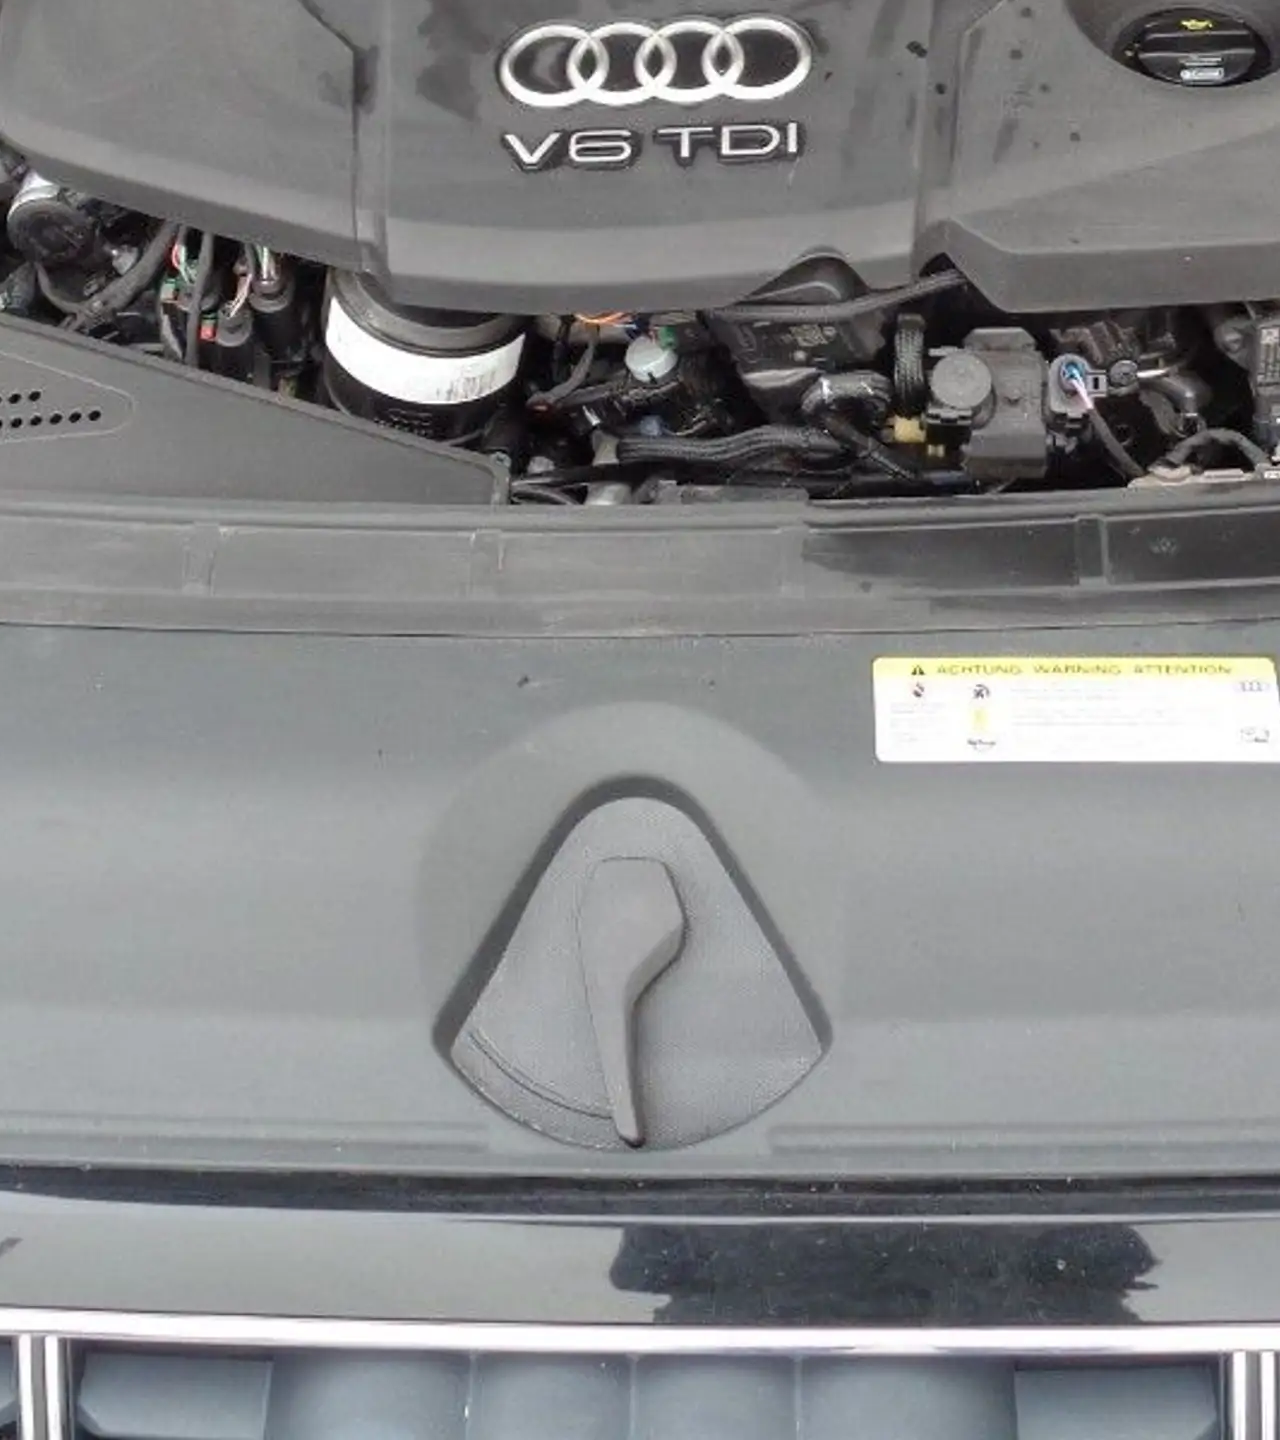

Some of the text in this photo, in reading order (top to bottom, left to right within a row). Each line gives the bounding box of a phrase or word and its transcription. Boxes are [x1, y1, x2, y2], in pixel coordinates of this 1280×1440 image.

[503, 122, 799, 167] V6 TDI
[937, 664, 1232, 675] ACHTUNG WARNING ATTENTION
